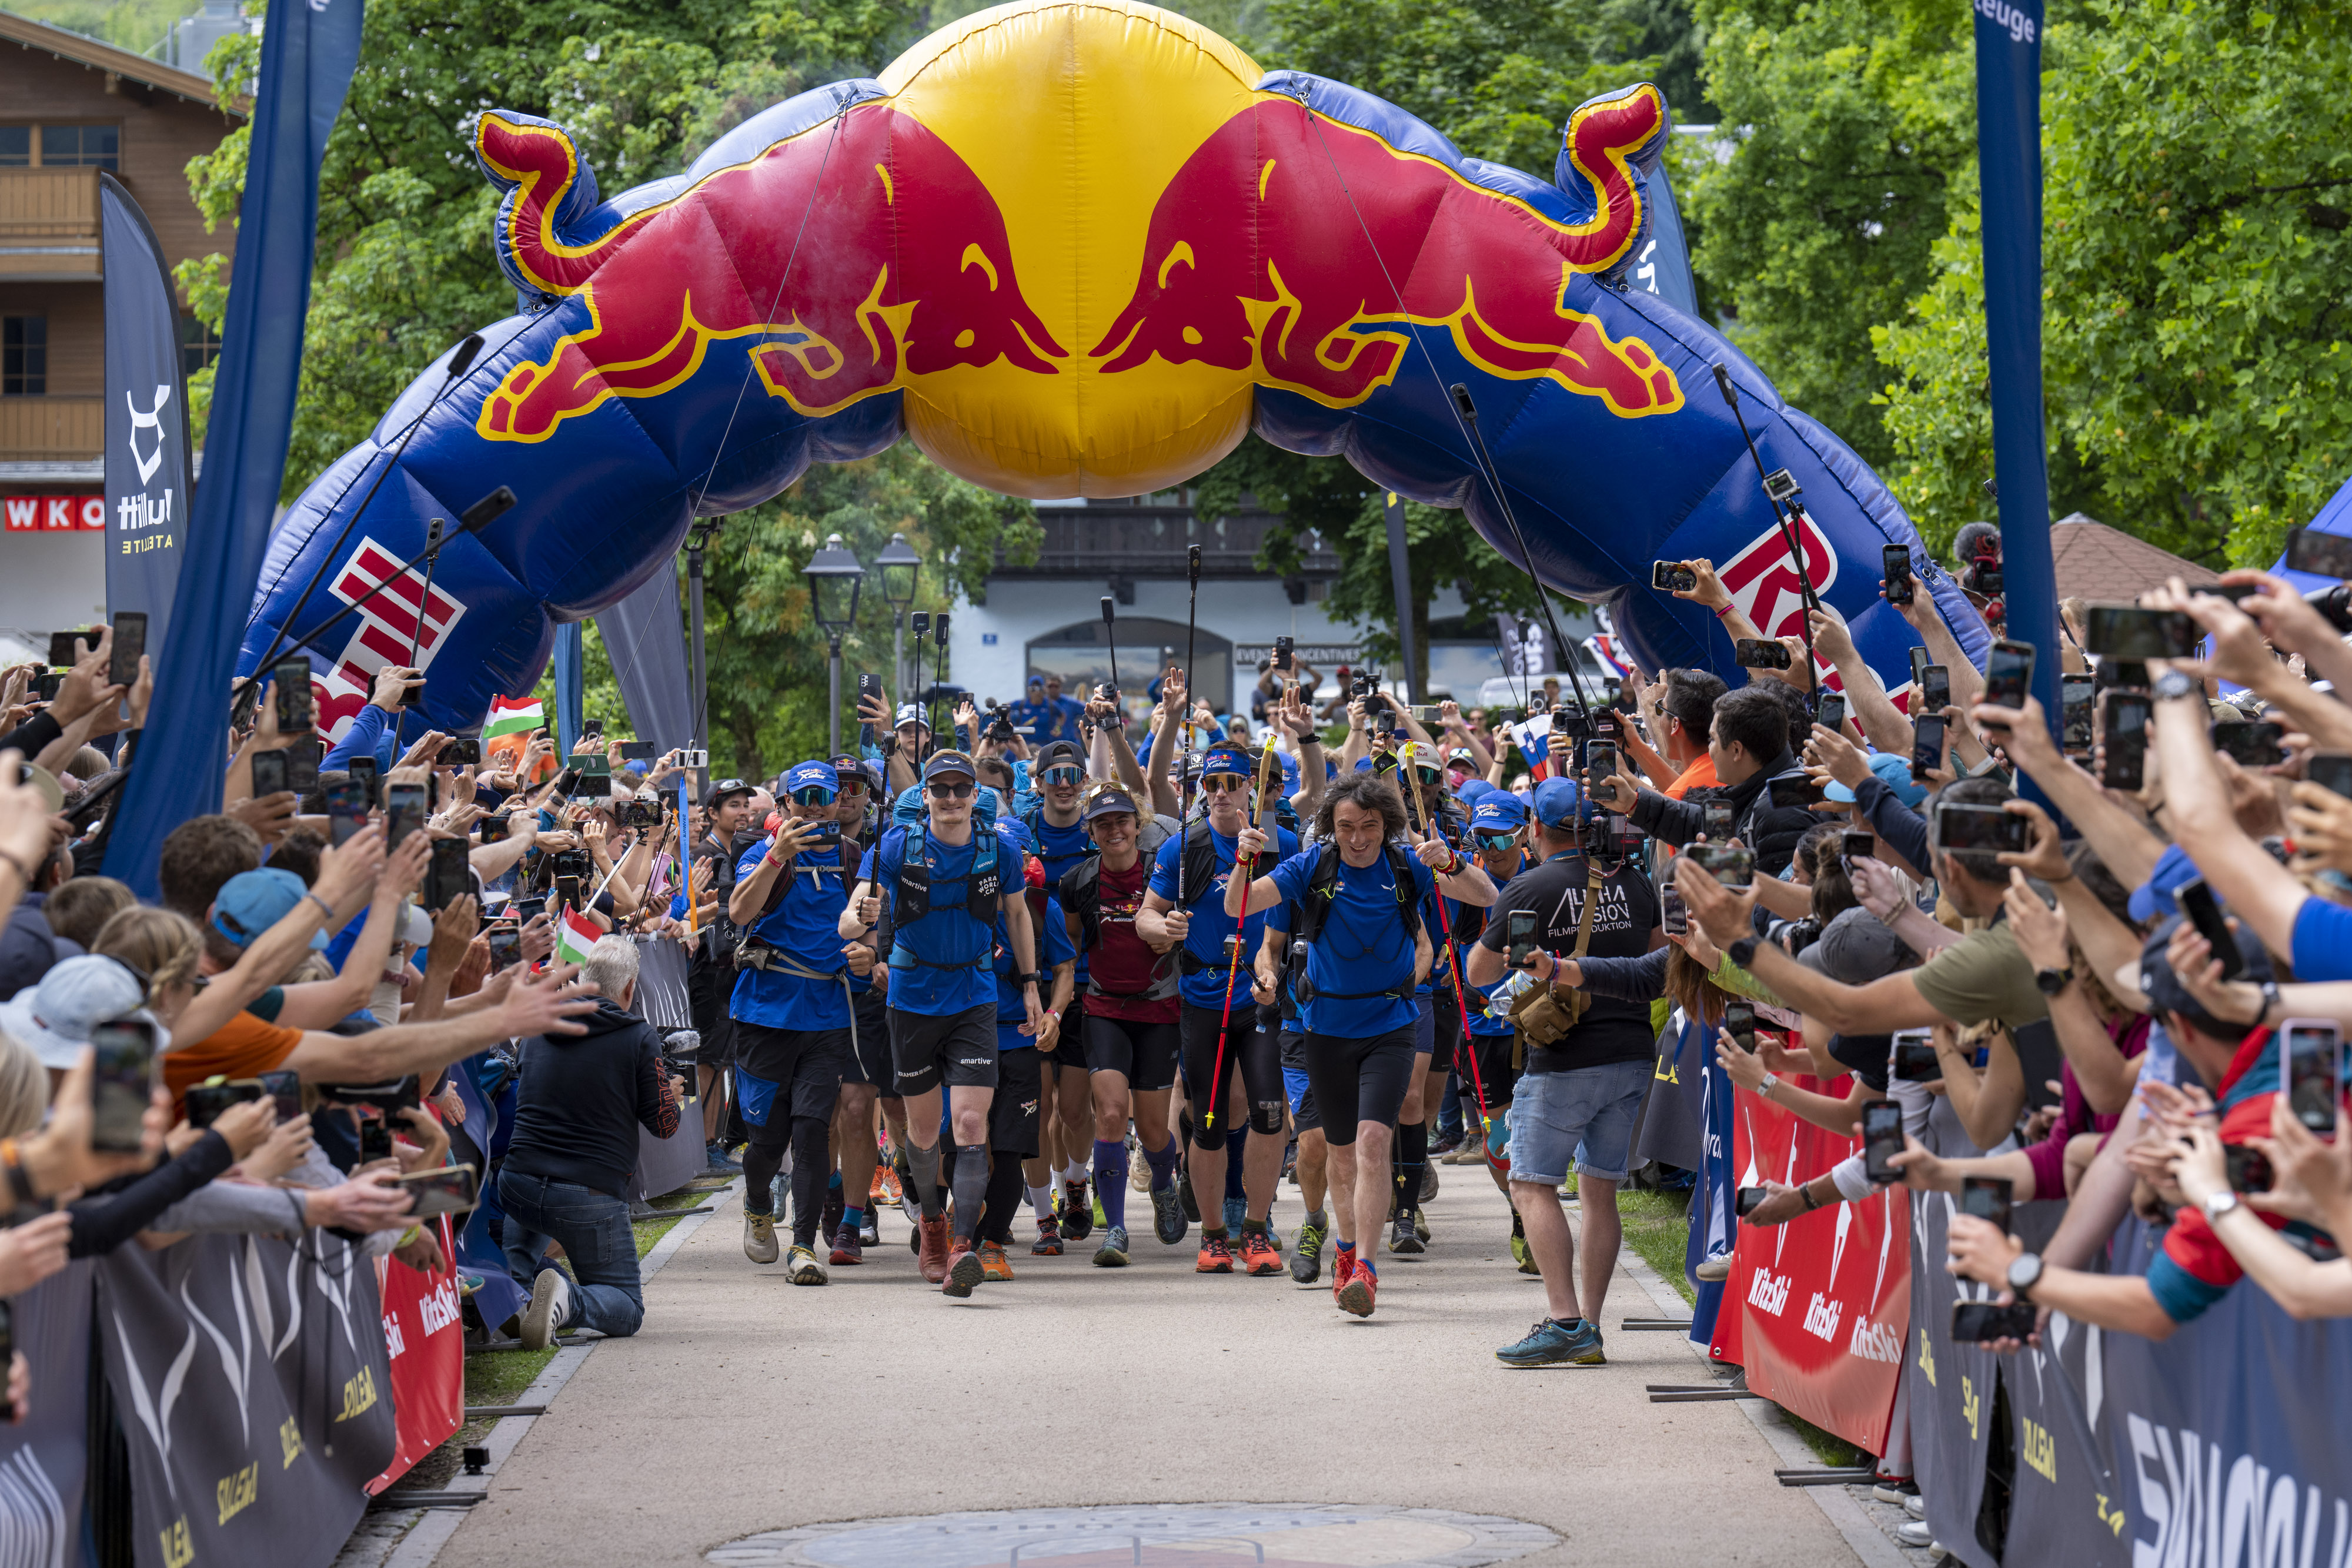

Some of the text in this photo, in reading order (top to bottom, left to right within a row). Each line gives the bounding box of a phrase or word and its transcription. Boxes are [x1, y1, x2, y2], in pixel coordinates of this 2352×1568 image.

[979, 875, 997, 886] PARA
[984, 888, 994, 897] .CH
[1748, 1266, 1792, 1317] KitzSki
[1803, 1292, 1843, 1343] KitzSki
[1850, 1315, 1902, 1365] KitzSki
